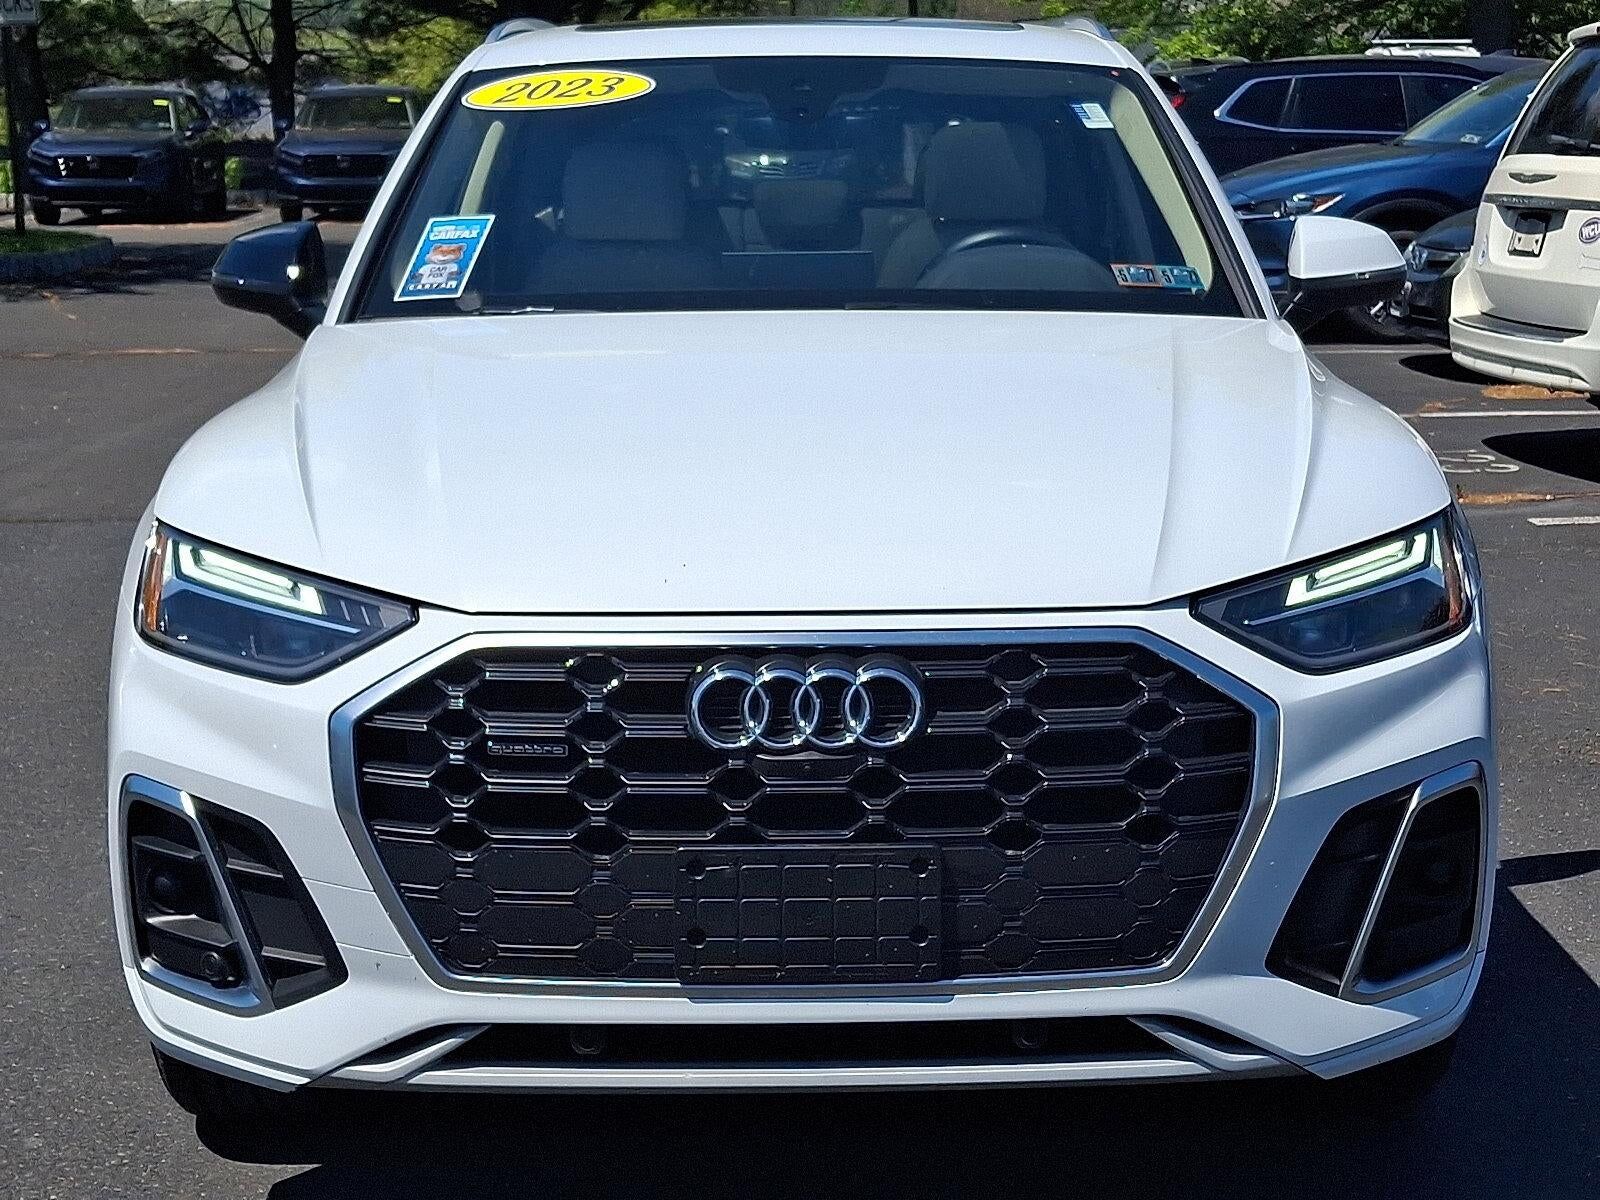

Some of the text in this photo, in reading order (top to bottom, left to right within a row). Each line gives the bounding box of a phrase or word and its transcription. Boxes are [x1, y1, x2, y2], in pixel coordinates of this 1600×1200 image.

[491, 76, 625, 105] 2023
[429, 229, 480, 241] CARFAX
[491, 744, 564, 755] quattro
